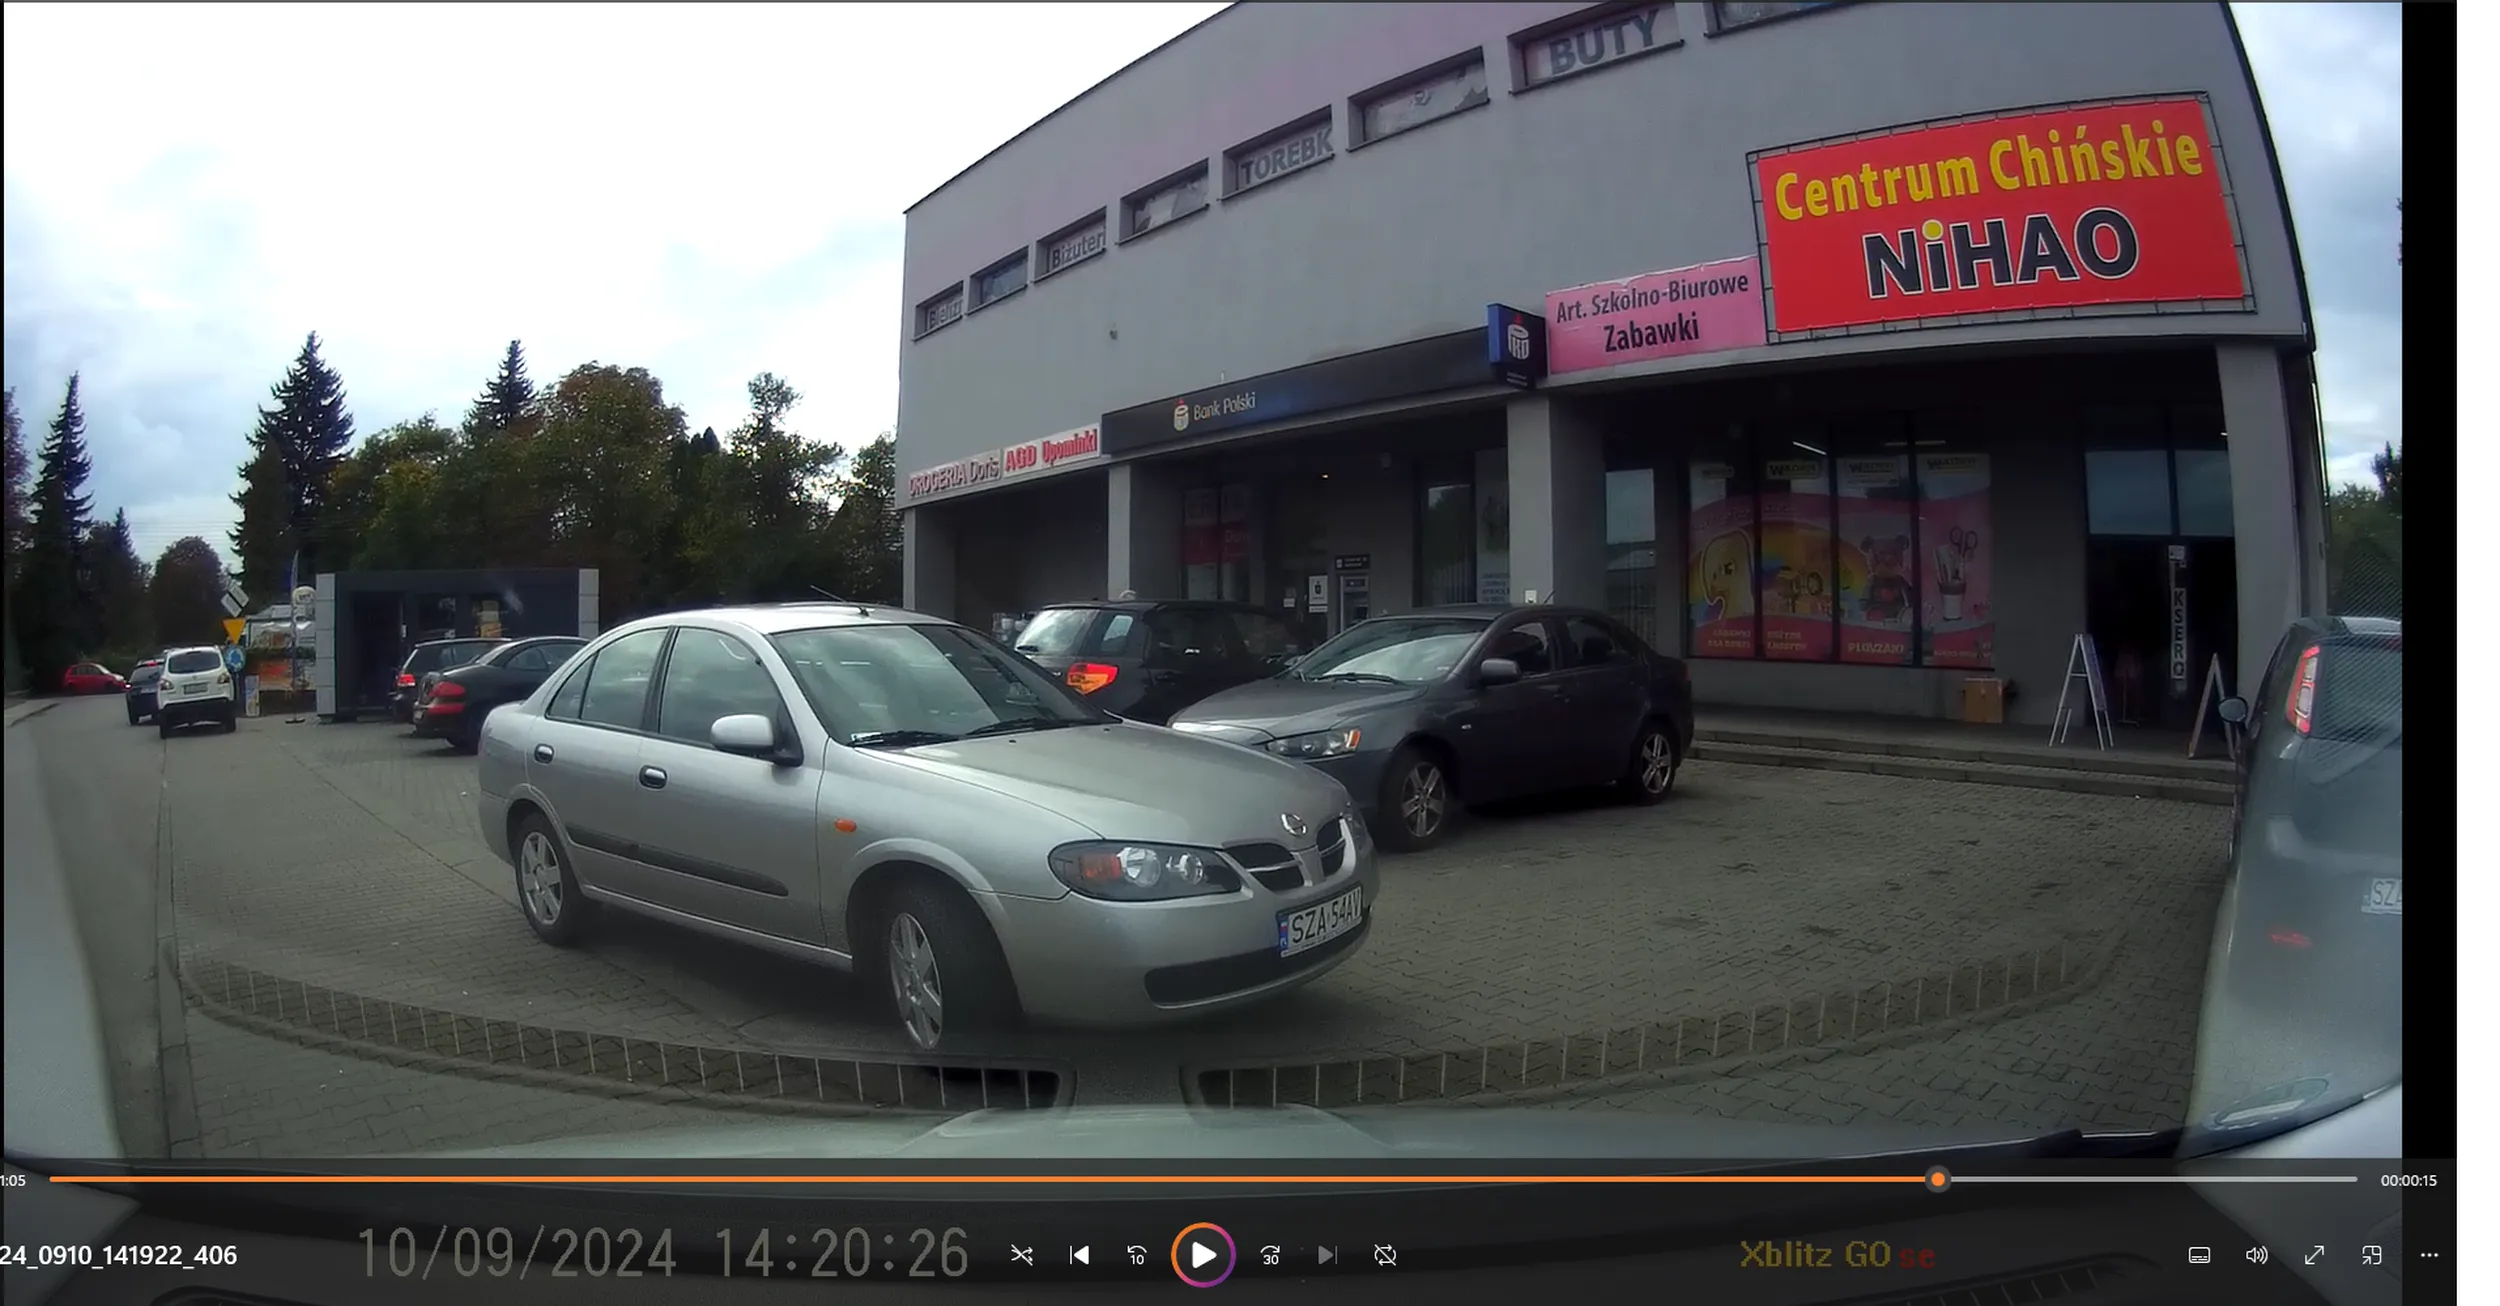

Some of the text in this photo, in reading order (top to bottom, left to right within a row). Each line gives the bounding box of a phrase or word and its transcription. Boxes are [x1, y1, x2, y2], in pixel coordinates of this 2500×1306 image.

[1550, 9, 1661, 75] BUTY
[1240, 127, 1334, 184] TOREBK
[1774, 119, 2204, 221] Centrum Chińskie
[1861, 206, 2139, 299] NiHAO
[1556, 274, 1749, 323] Art. Szkolno-Biurowe
[1604, 311, 1700, 353] Zabawki
[1193, 391, 1256, 421] Bank Polski
[1004, 428, 1097, 472] AGD Upominki
[908, 457, 1000, 497] DROGERIA Doris
[2173, 590, 2185, 677] KSERO
[1292, 906, 1327, 944] SZA
